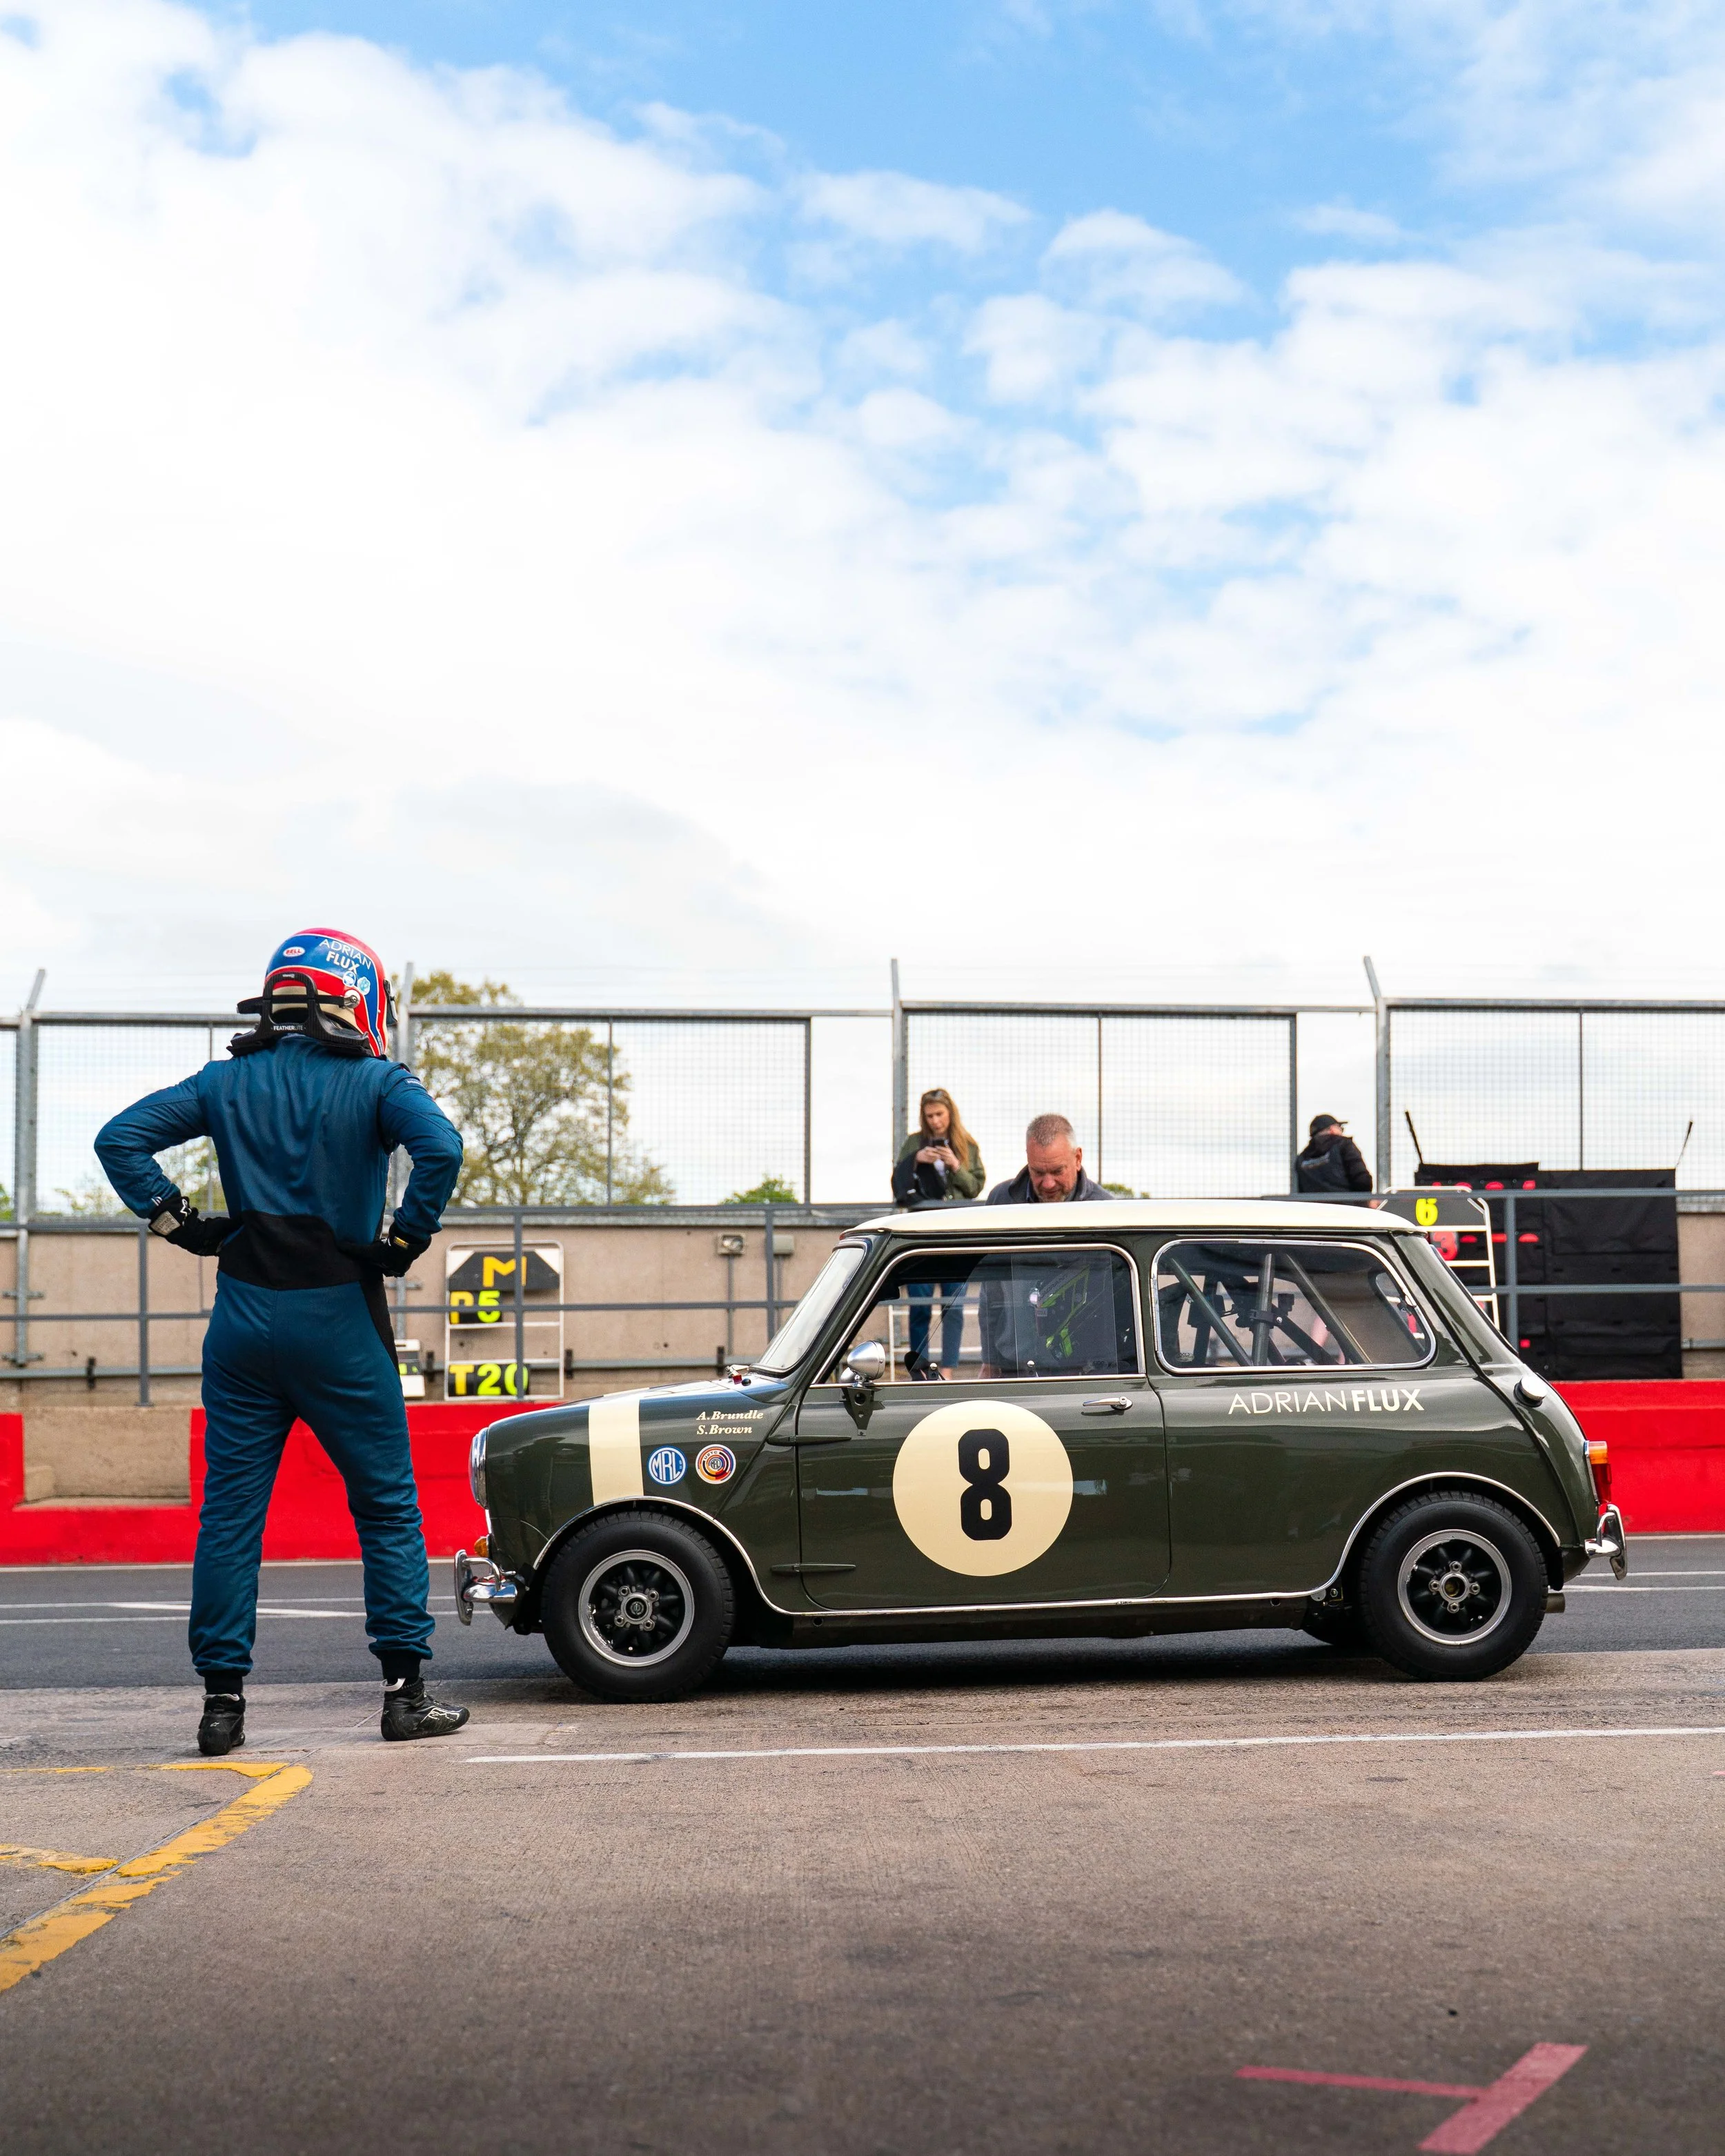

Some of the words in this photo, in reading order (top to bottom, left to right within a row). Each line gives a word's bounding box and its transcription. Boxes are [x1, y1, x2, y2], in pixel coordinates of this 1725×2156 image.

[319, 938, 372, 970] ADRIAN
[326, 951, 359, 975] FLUX
[1415, 1198, 1438, 1226] 6
[483, 1256, 527, 1287] M
[448, 1363, 529, 1396] T20
[696, 1410, 764, 1421] A.Brundle
[696, 1424, 753, 1435] S.Brown
[651, 1450, 681, 1481] MRL
[958, 1428, 1012, 1541] 8
